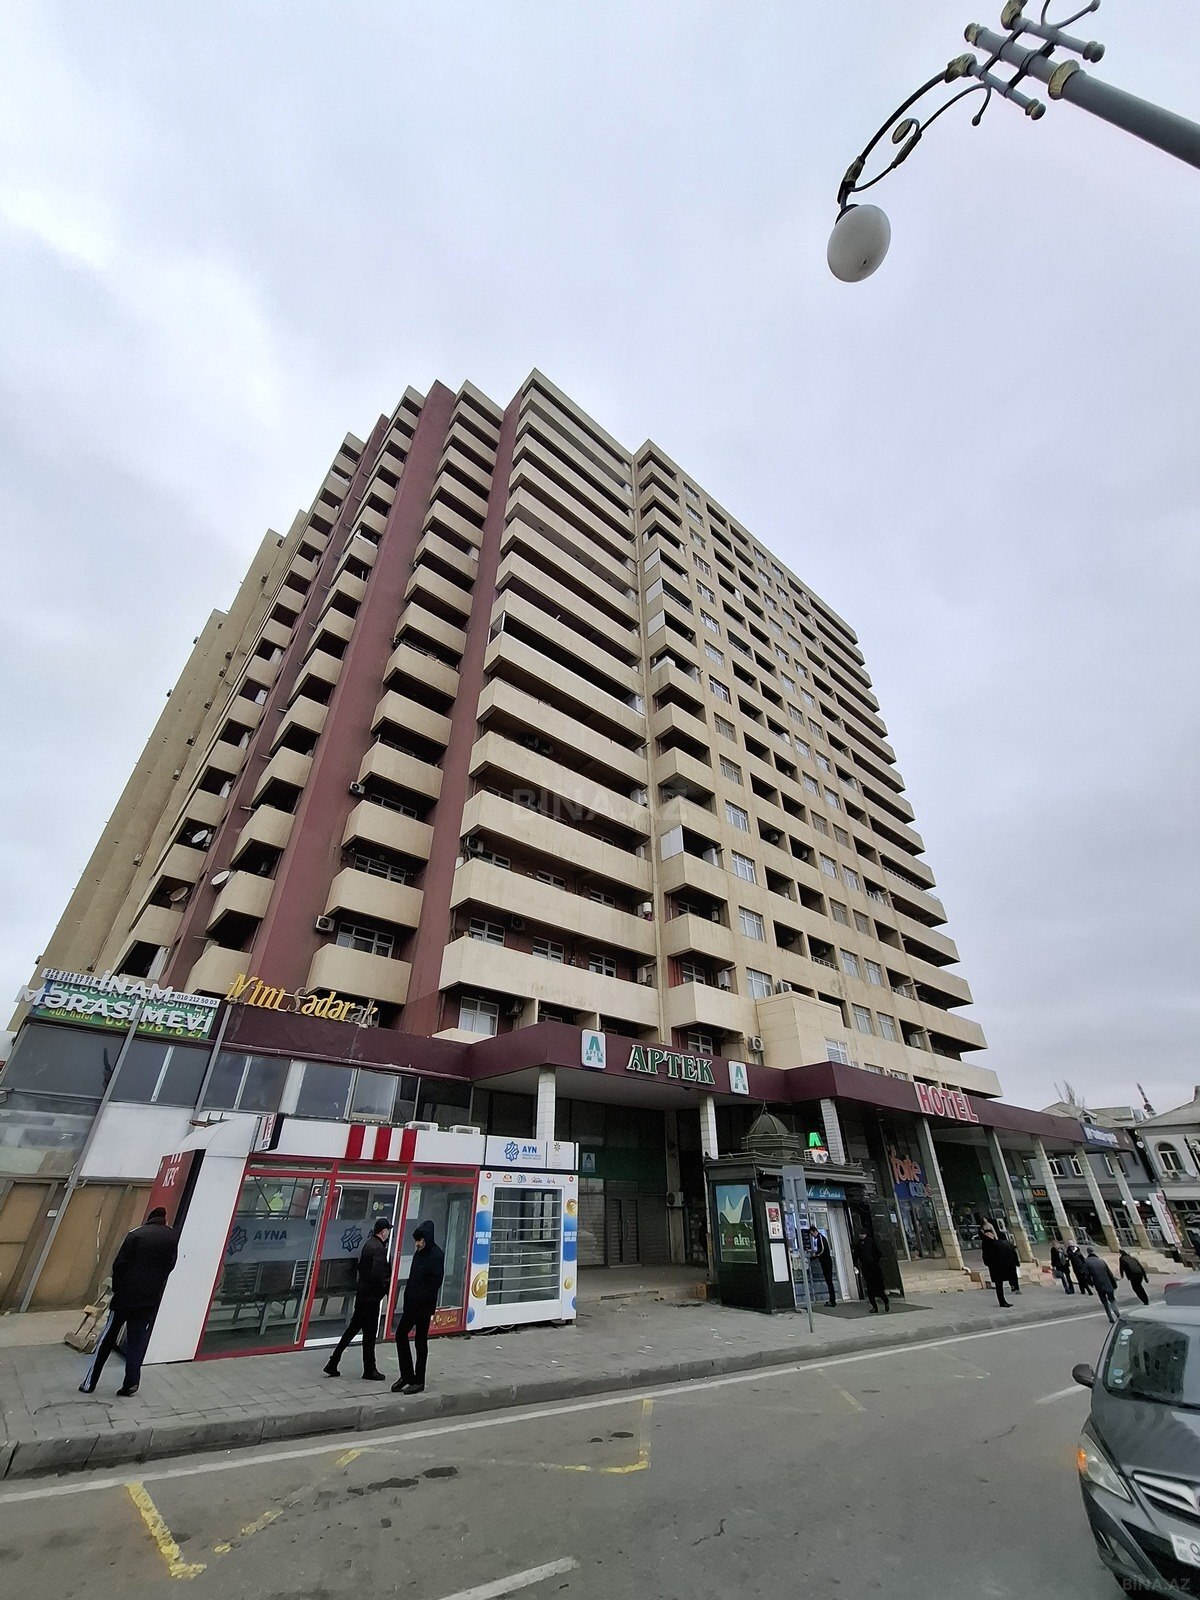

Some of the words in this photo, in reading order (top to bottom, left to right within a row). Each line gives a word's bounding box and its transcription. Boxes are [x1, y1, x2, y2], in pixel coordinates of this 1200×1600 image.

[98, 969, 173, 1003] İNAM
[626, 1044, 716, 1085] APTEK
[913, 1081, 980, 1123] HOTEL
[254, 1229, 288, 1241] AYNA
